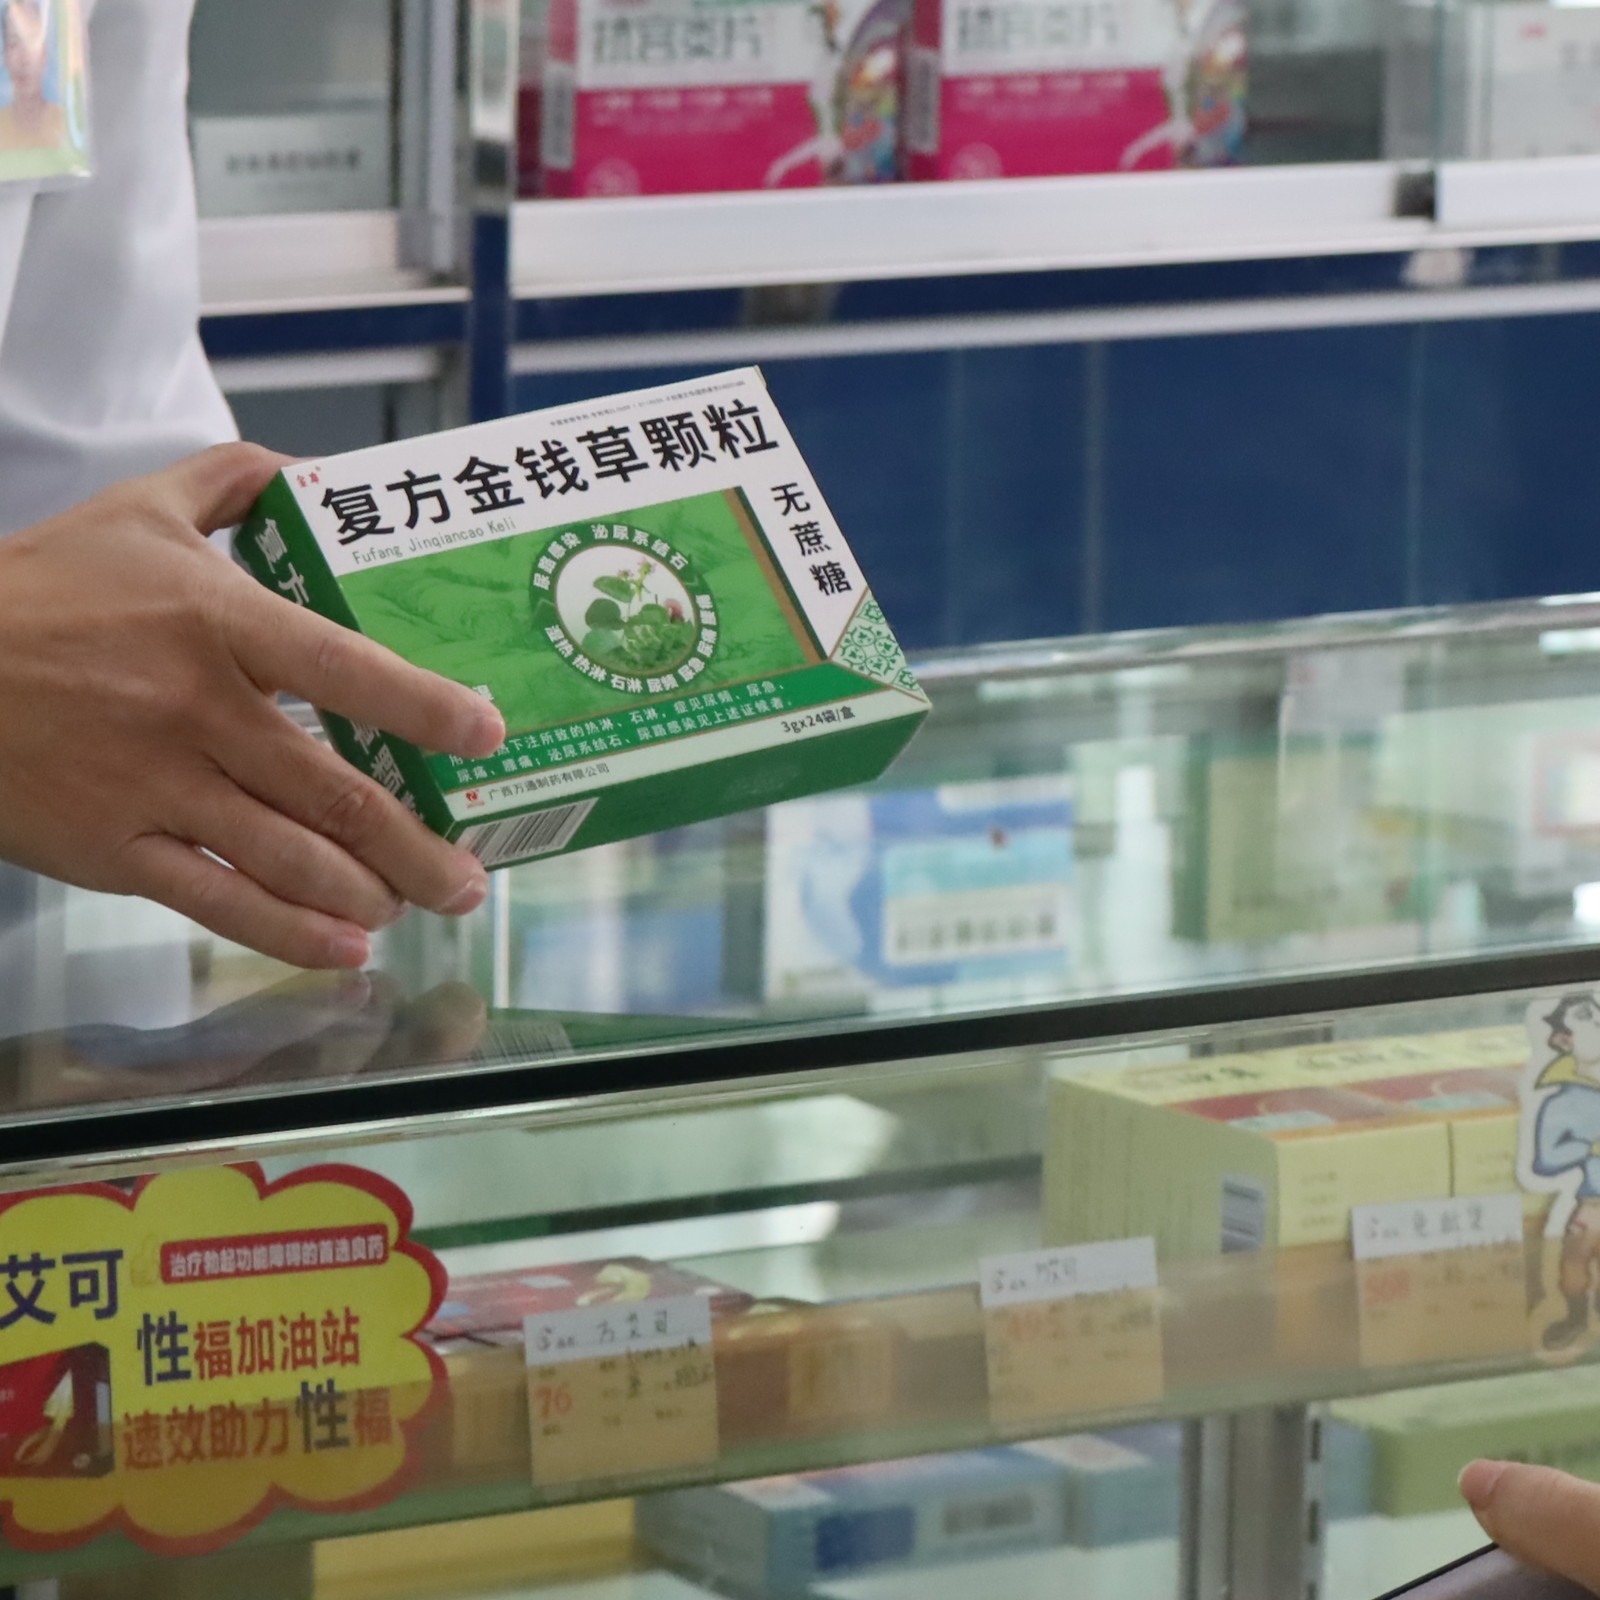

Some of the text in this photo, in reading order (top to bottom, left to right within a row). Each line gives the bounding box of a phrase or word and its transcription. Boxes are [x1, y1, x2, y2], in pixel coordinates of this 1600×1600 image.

[591, 14, 762, 65] 抗宫炎片
[954, 4, 1120, 56] 抗宫炎片
[320, 398, 779, 546] 复方金钱草颗粒
[352, 516, 517, 565] Fufang Jinqiancao Keli
[532, 523, 689, 591] 尿路感染 泌尿系结石
[771, 480, 853, 598] 无蔗糖
[571, 653, 608, 683] 热淋
[610, 673, 644, 694] 石淋
[646, 673, 679, 694] 尿频
[487, 762, 611, 800] 广西万通制药有限公司
[168, 1233, 385, 1279] 治疗勃起功能障碍的首选良药
[136, 1305, 361, 1388] 性福加油站
[122, 1378, 394, 1472] 速效助力性福
